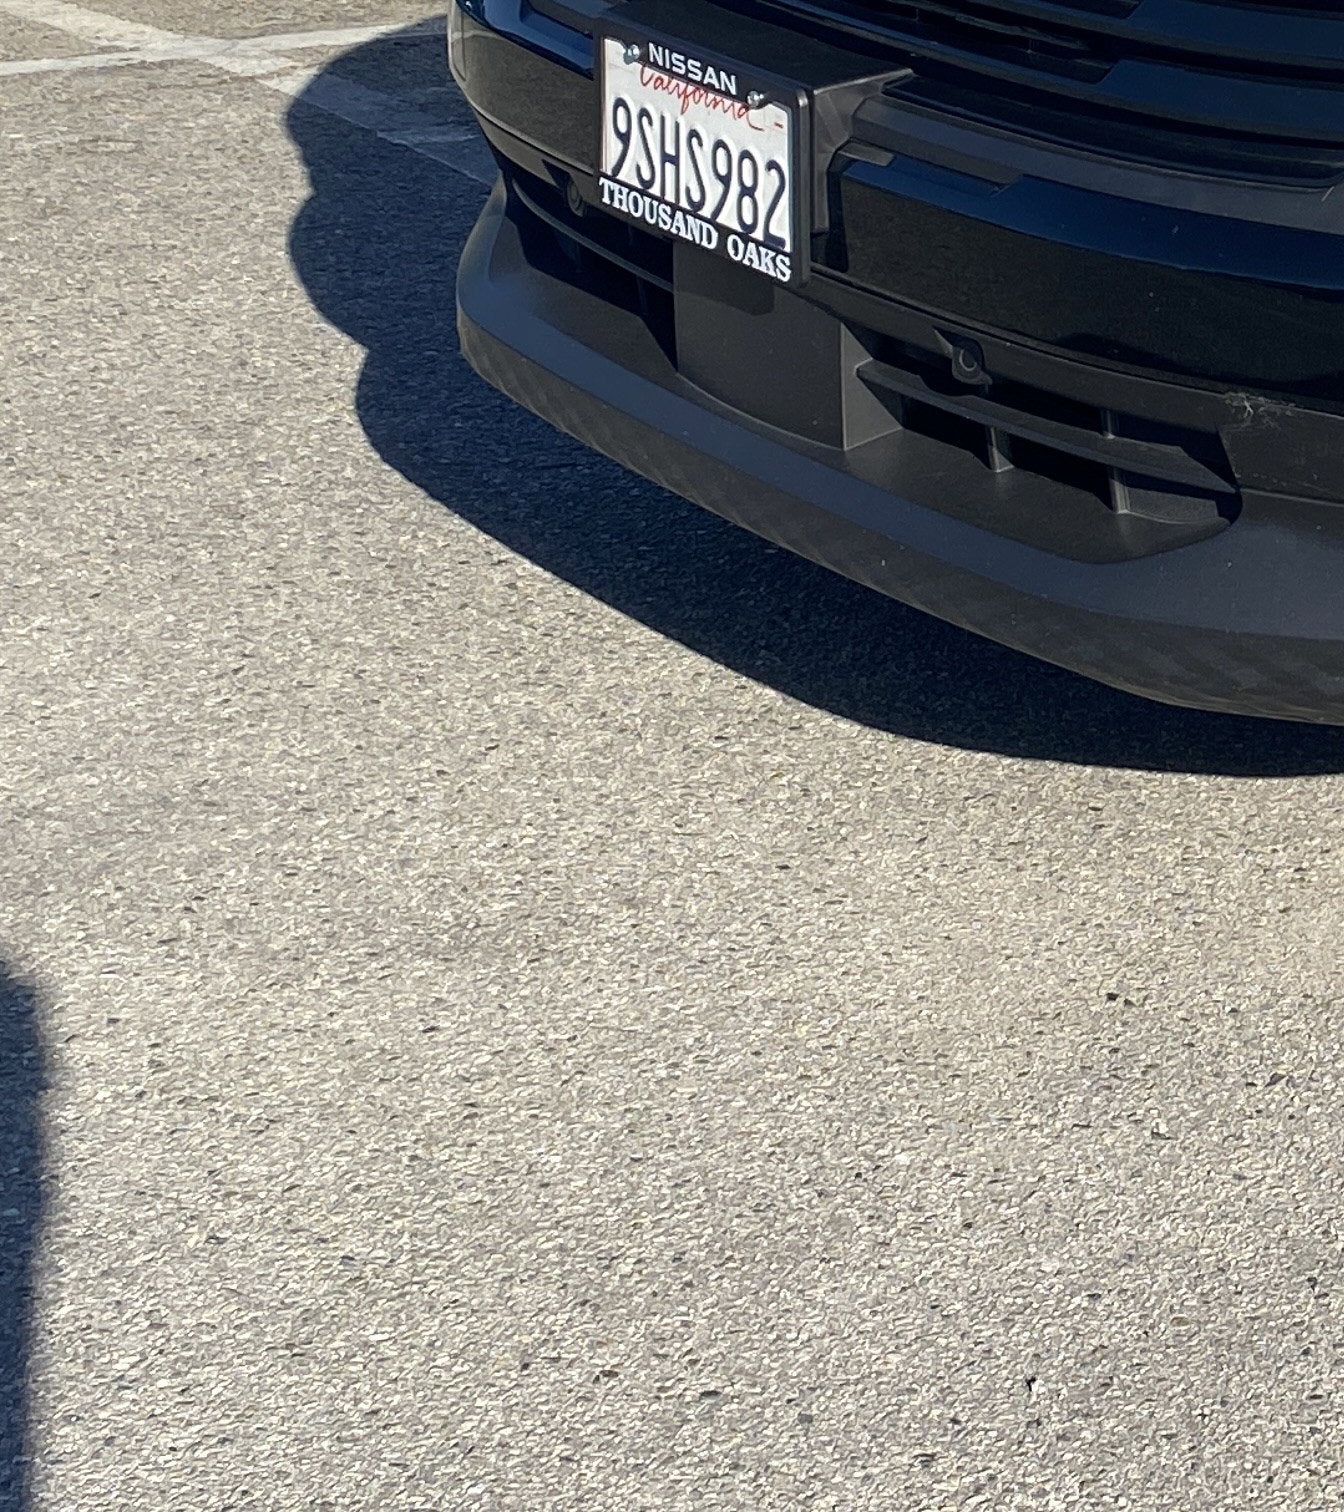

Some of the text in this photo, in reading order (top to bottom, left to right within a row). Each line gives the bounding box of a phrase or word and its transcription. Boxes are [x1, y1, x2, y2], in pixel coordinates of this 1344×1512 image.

[648, 42, 737, 95] NISSAN
[612, 96, 786, 250] 9SHS982
[599, 176, 791, 282] THOUSAND OAKS
